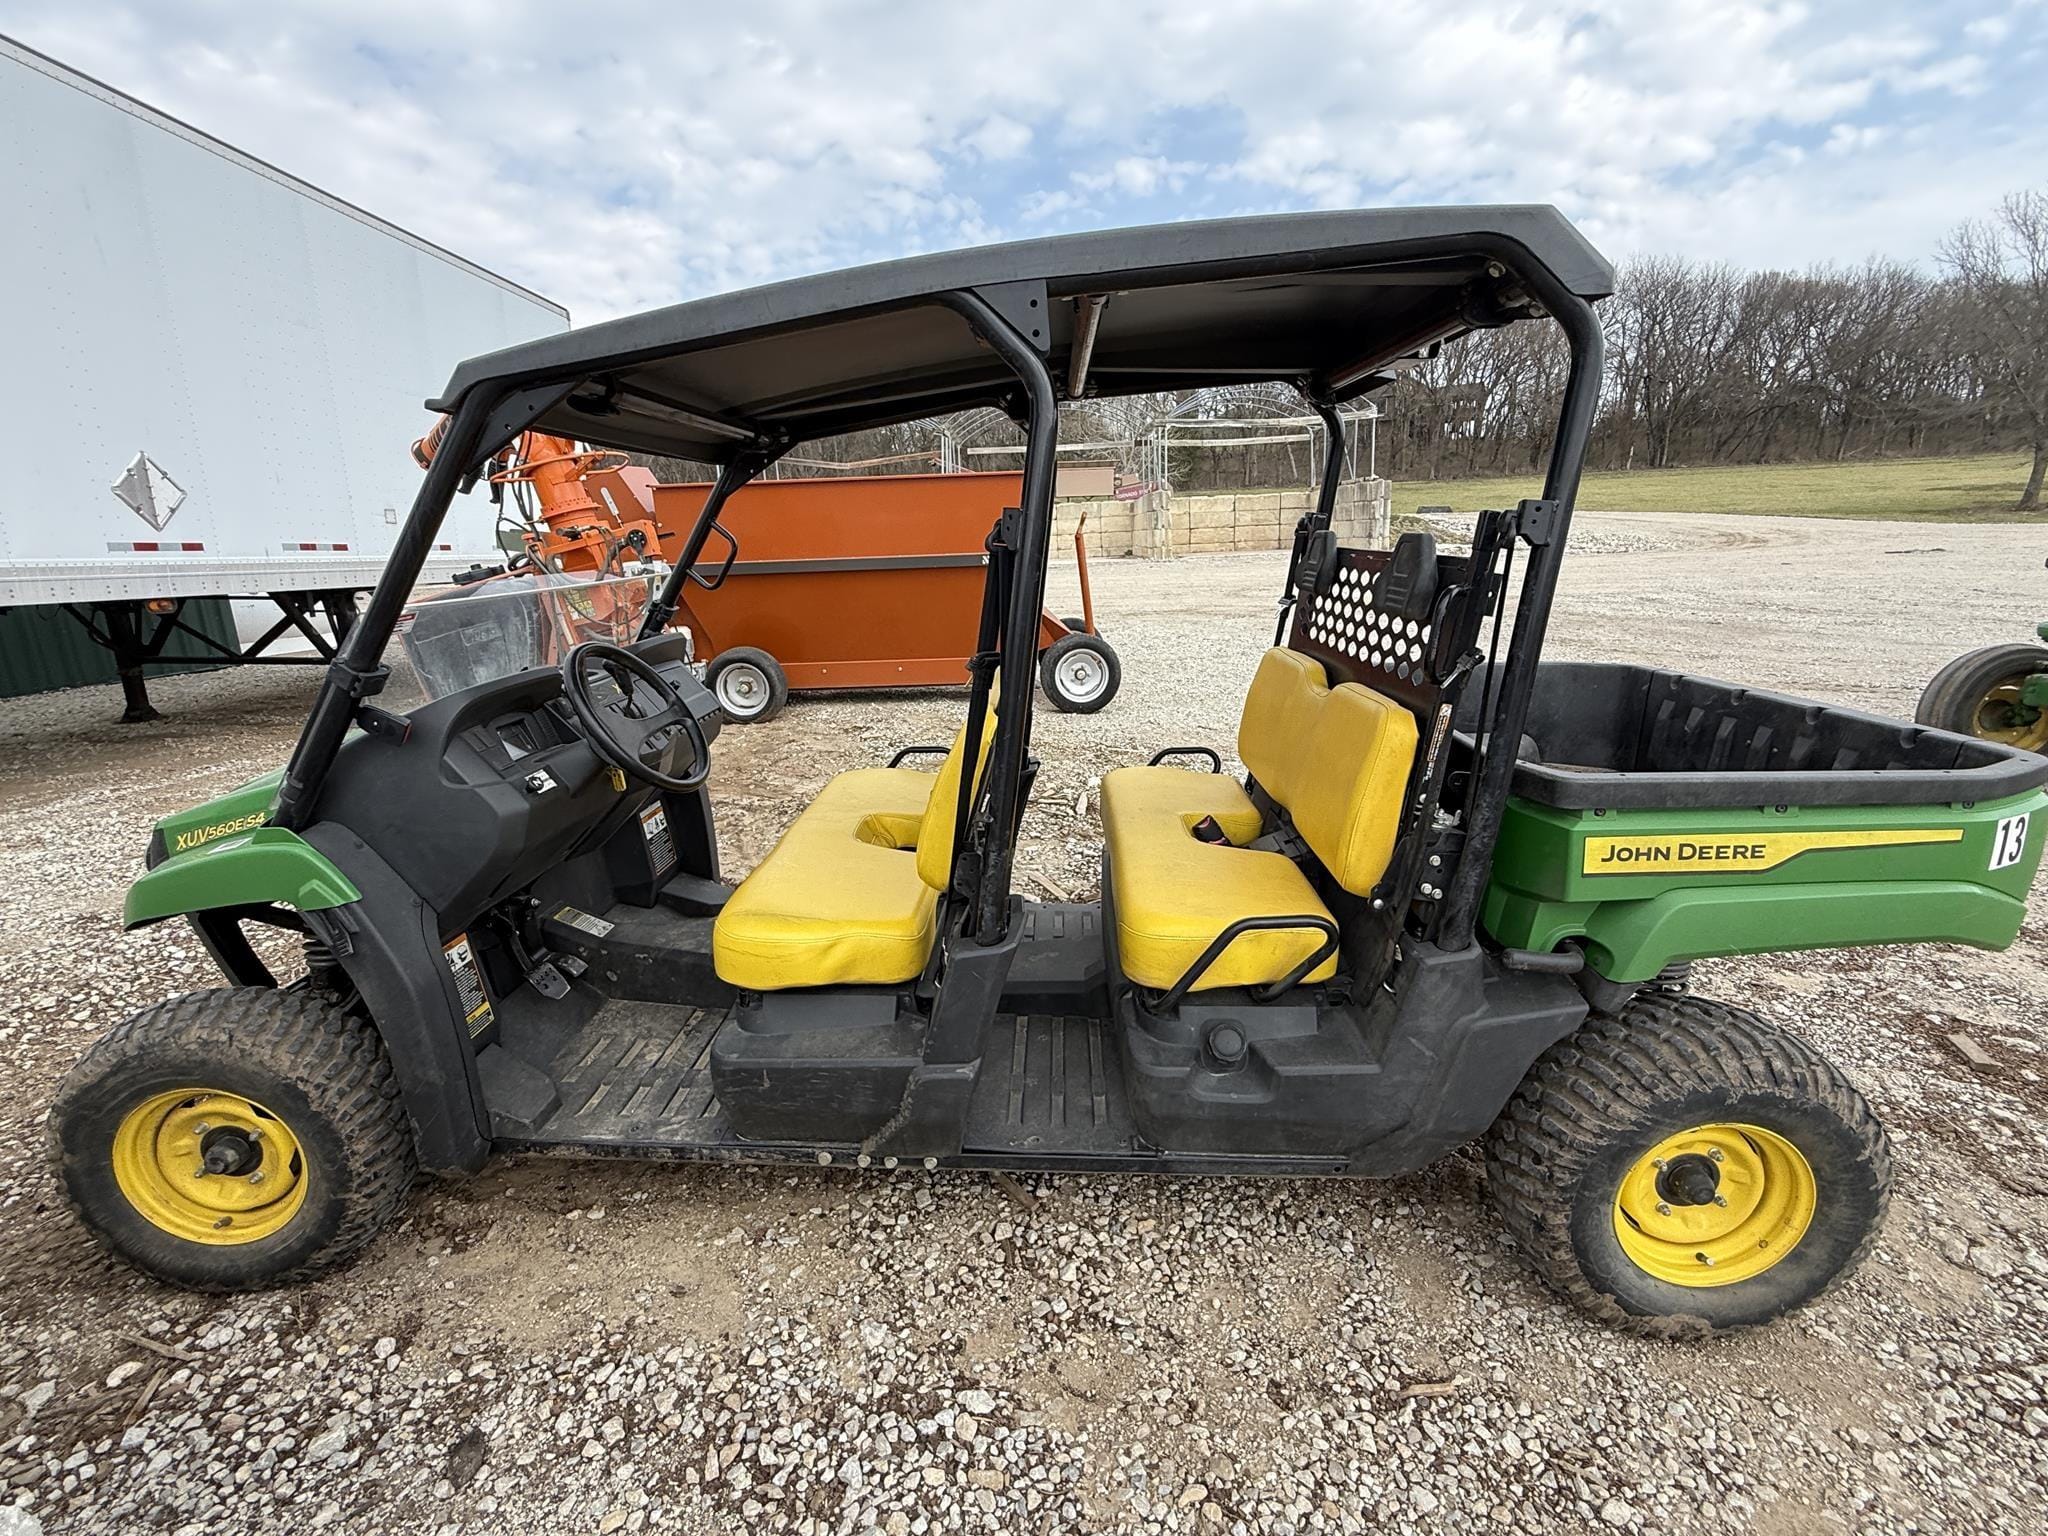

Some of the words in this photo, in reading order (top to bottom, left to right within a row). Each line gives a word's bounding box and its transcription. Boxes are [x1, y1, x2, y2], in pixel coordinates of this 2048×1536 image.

[176, 818, 245, 851] XUV560E
[246, 812, 265, 827] S4
[1996, 816, 2026, 866] 13
[1601, 844, 1671, 863] JOHN
[1677, 842, 1766, 861] DEERE
